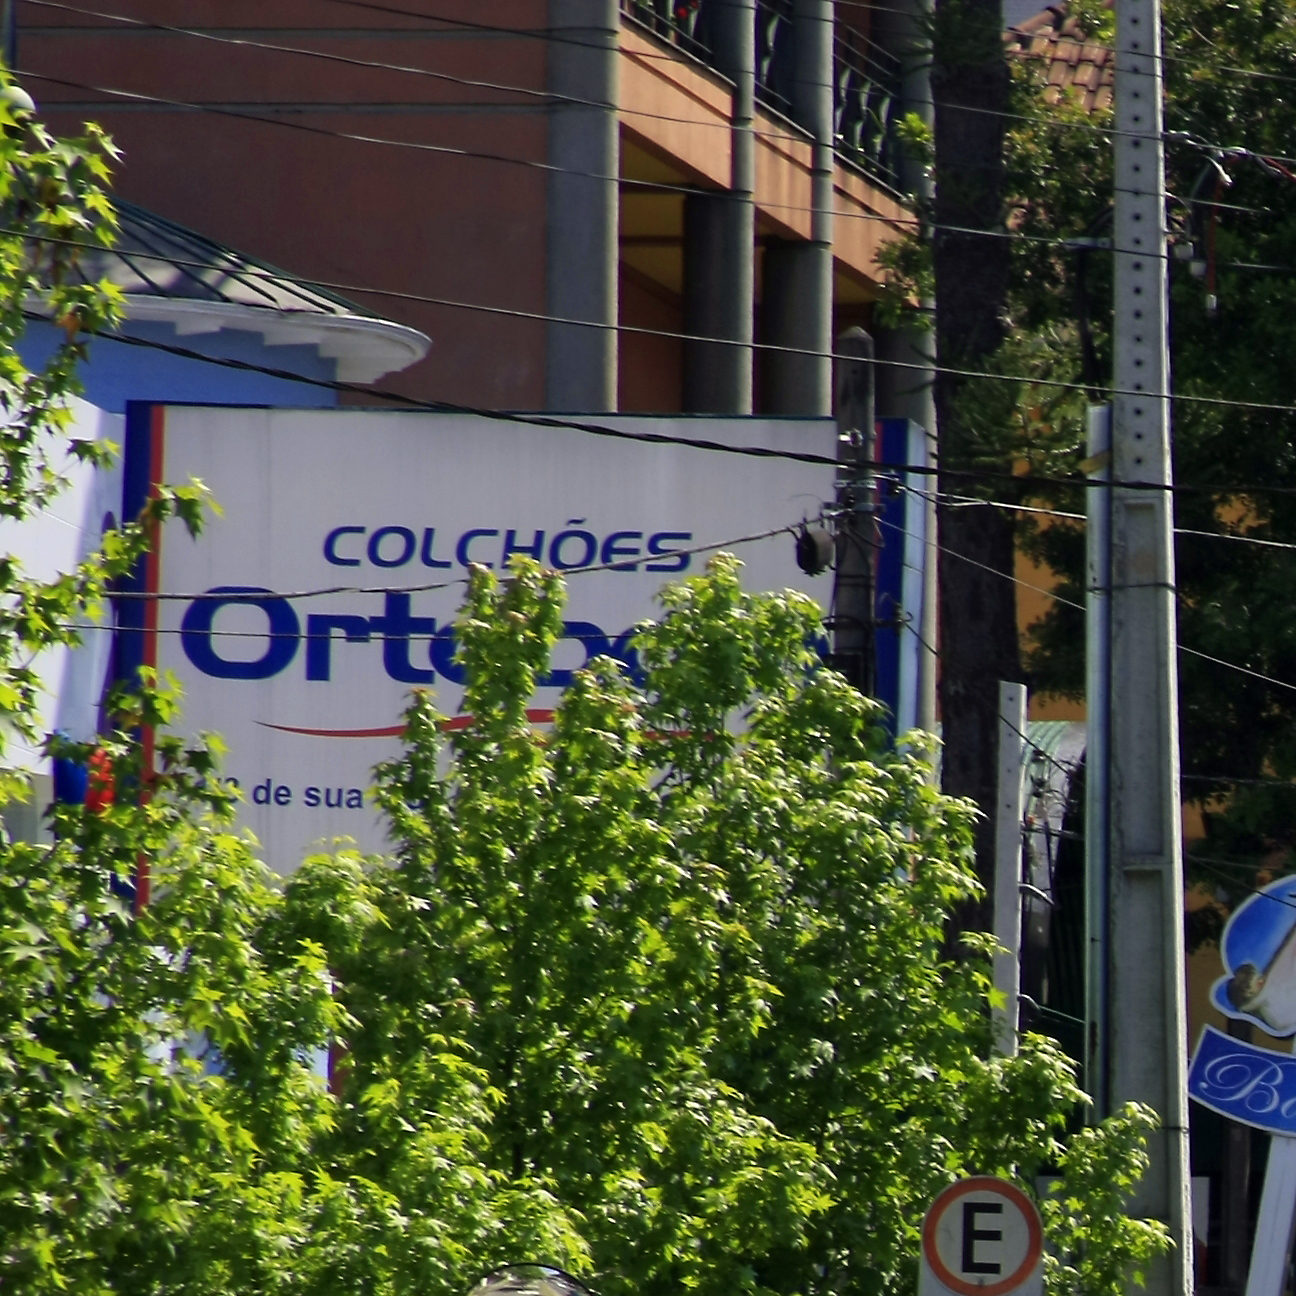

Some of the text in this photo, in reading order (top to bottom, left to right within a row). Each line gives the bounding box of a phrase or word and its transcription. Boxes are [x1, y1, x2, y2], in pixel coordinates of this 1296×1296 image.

[322, 517, 693, 573] COLCHÕES
[252, 778, 293, 806] de
[303, 784, 364, 810] sua
[961, 1202, 1004, 1275] E
